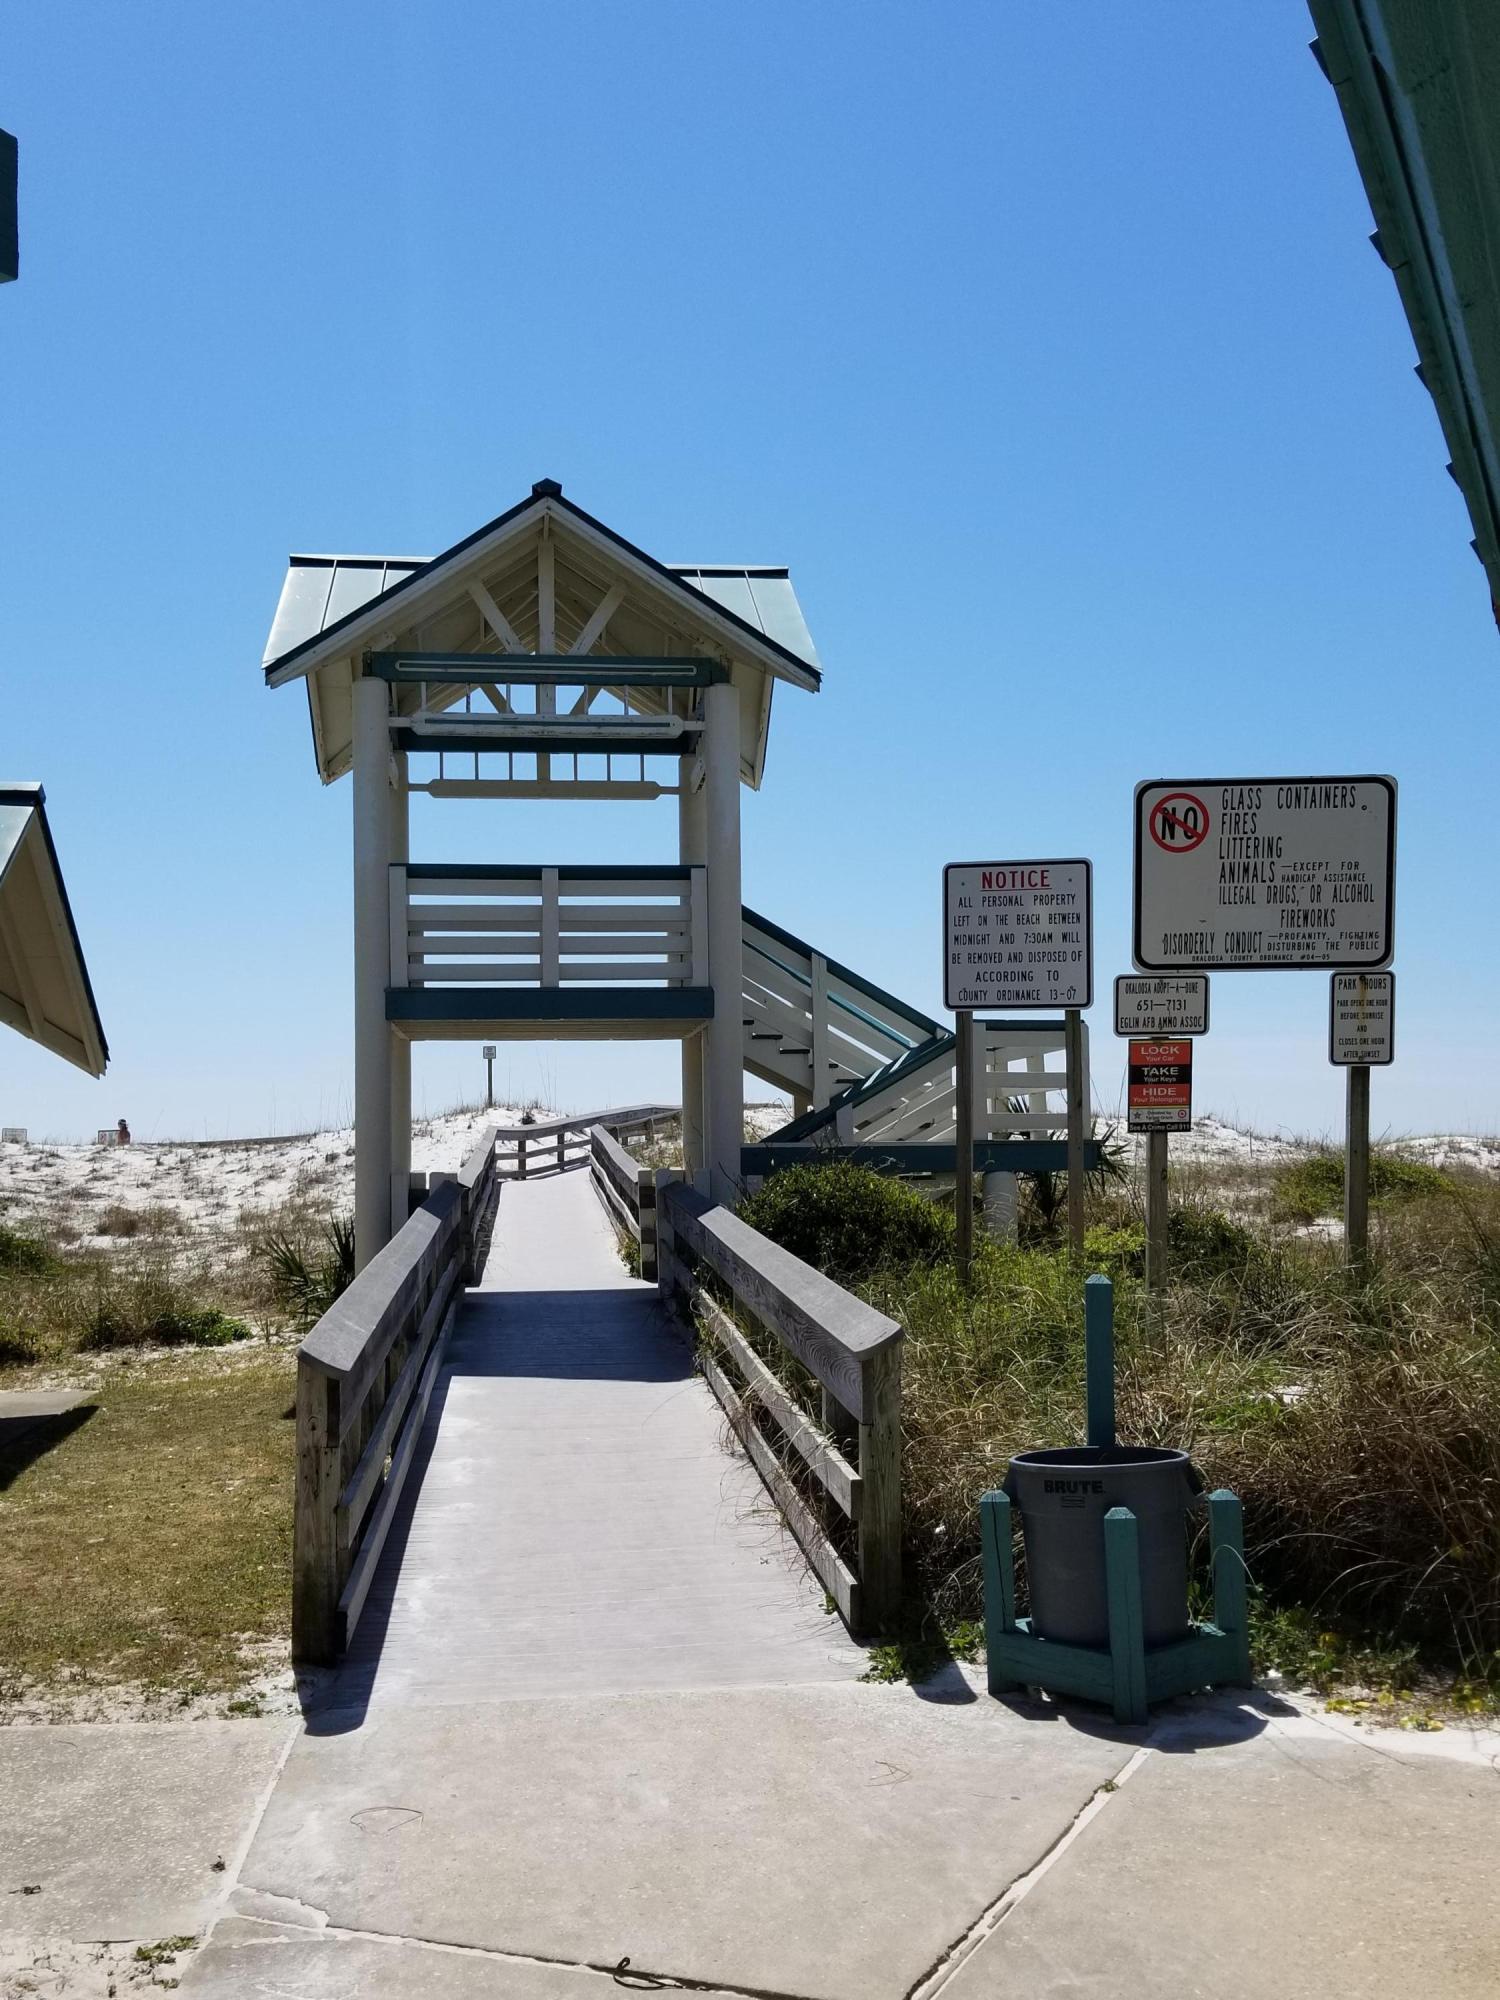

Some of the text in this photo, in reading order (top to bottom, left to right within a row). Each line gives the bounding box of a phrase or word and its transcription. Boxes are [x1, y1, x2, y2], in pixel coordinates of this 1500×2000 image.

[1222, 786, 1357, 810] GLASS CONTAINERS
[1160, 806, 1198, 840] NO
[1221, 812, 1257, 835] FIRES
[1219, 836, 1283, 859] LITTERING
[1219, 861, 1275, 884] ANIMALS
[1341, 861, 1360, 870] FOR
[982, 869, 1050, 889] NOTICE
[1281, 873, 1366, 883] HANDICAP ASSISTANCE
[958, 893, 1076, 908] ALL PERSONAL PROPERTY
[1219, 883, 1375, 906] ILLEGAL DRUGS, OR ALCOHOL
[953, 912, 1081, 927] LEFT ON THE BEACH BETWEEN
[1280, 909, 1336, 928] FIREWORKS
[954, 931, 1080, 946] MIDNIGHT AND 7:30AM WILL
[1339, 931, 1380, 940] FIGHTING
[1163, 931, 1263, 955] DISORDERLY CONDUCT
[1267, 940, 1380, 951] DISTURBING THE PUBLIC
[952, 950, 1083, 965] BE REMOVED AND DISPOSED OF
[1192, 954, 1224, 962] OKALOOSA
[1229, 954, 1253, 962] COUNTY
[1259, 953, 1294, 961] ORDINANCE
[975, 970, 1059, 983] ACCORDING TO
[1125, 982, 1151, 994] OKALOOSA
[1338, 977, 1387, 991] PARK HOURS
[958, 988, 1077, 1002] COUNTY ORDINANCE 13-07
[1120, 1016, 1202, 1028] EGLIN AFB AMMO ASSOC
[1340, 1011, 1384, 1020] BEFORE SUNRISE
[1356, 1024, 1368, 1033] AND
[1338, 1037, 1358, 1046] CLOSES
[1359, 1037, 1370, 1045] ONE
[1140, 1046, 1180, 1055] LOCK
[1343, 1050, 1358, 1058] AFTER
[1141, 1066, 1180, 1076] TAKE
[1142, 1087, 1177, 1096] HIDE
[1043, 1479, 1104, 1494] BRUTE
